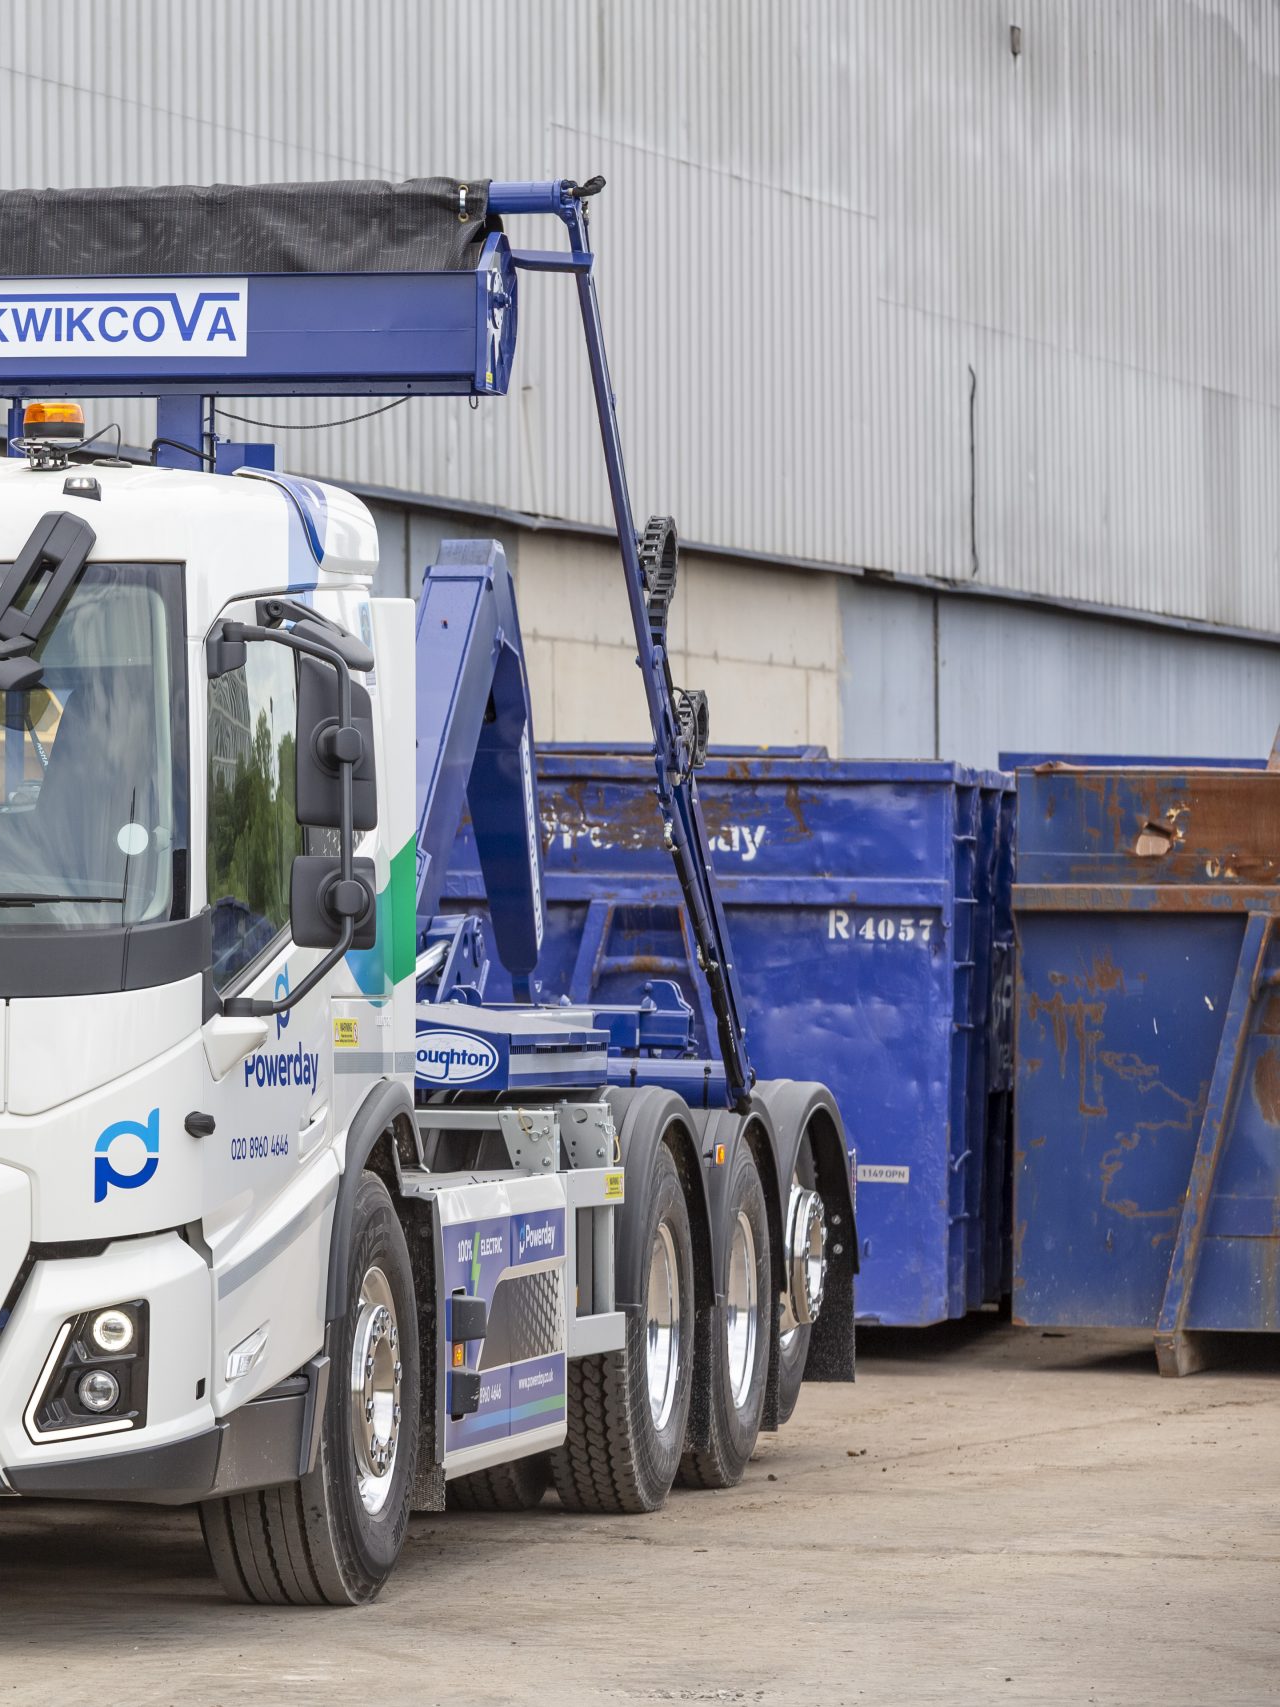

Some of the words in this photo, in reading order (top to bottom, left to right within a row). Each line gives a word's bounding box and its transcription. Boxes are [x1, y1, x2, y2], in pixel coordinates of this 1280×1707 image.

[828, 909, 850, 939] R
[858, 917, 934, 941] 4057
[244, 1040, 319, 1096] Powerday
[416, 1048, 490, 1078] oughton
[231, 1138, 246, 1161] 020
[250, 1136, 269, 1159] 8960
[271, 1134, 289, 1157] 4646
[457, 1239, 473, 1262] 100%
[481, 1236, 502, 1256] ELECTRIC
[525, 1220, 555, 1250] Powerday
